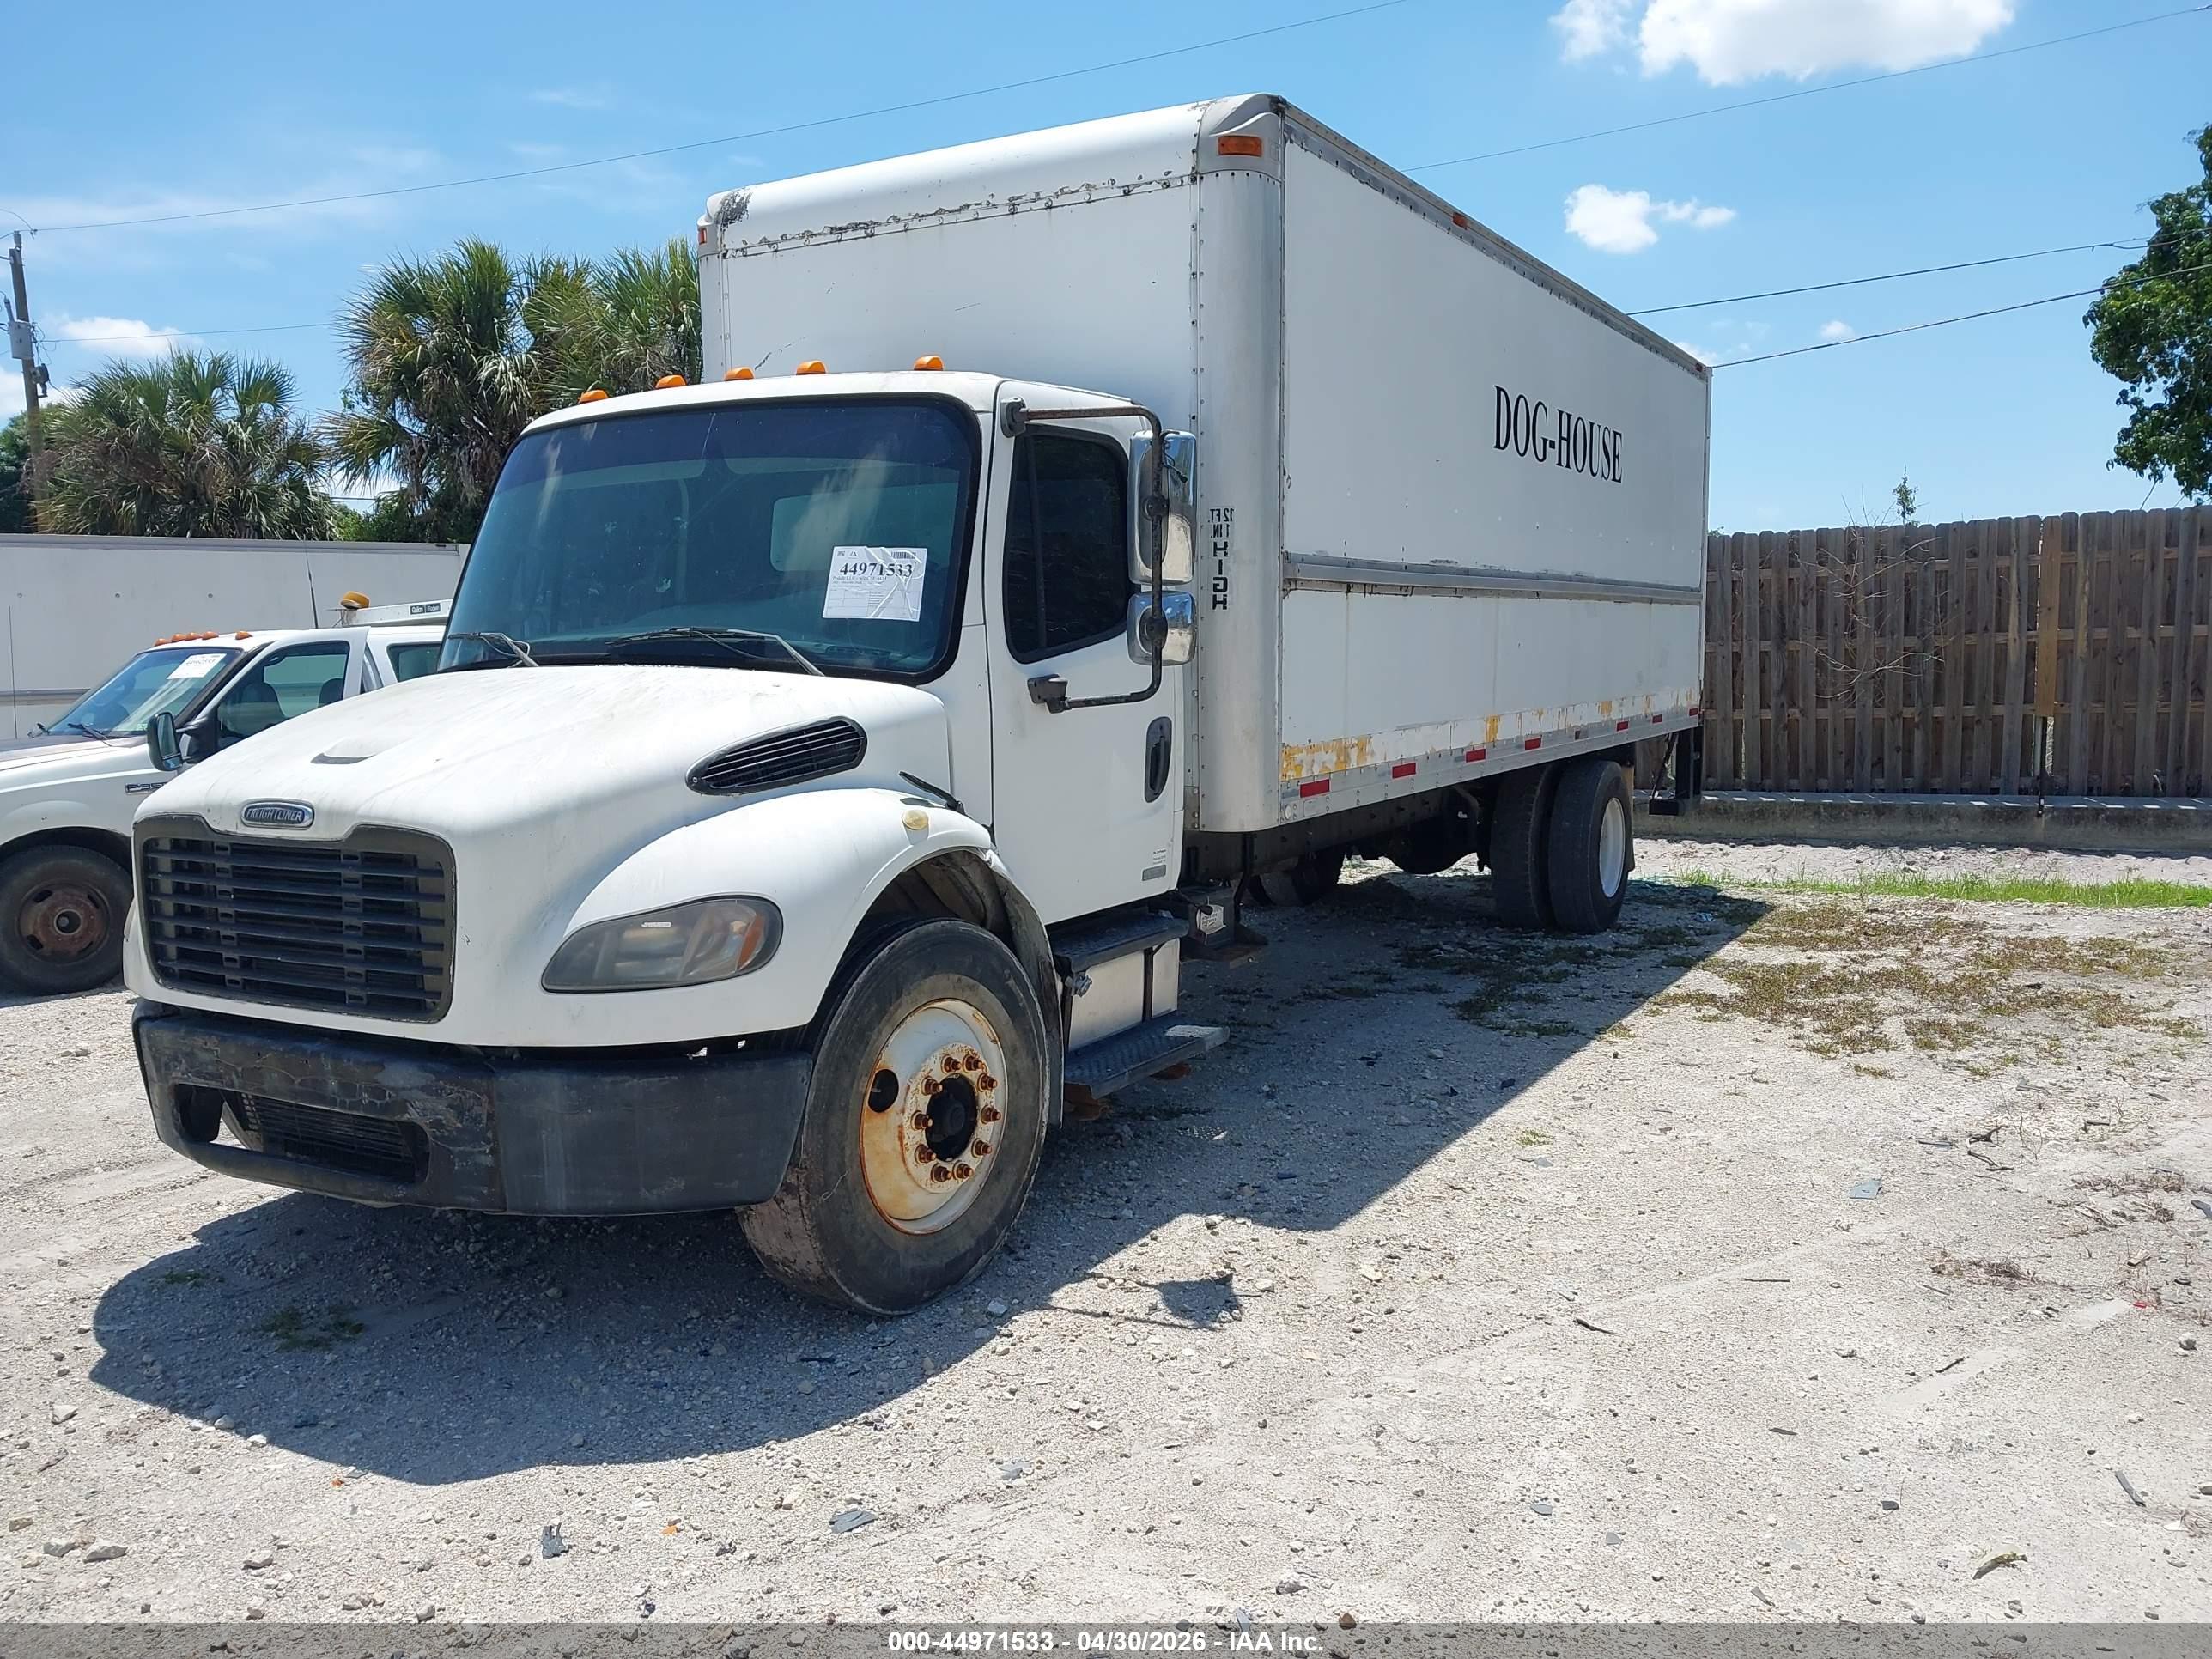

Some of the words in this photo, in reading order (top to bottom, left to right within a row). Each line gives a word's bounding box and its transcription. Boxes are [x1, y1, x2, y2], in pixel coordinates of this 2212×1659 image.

[1493, 385, 1623, 483] DOG-HOUSE
[839, 562, 913, 578] 44971533
[126, 782, 167, 793] F-35
[246, 807, 303, 822] FREIGHTLINER
